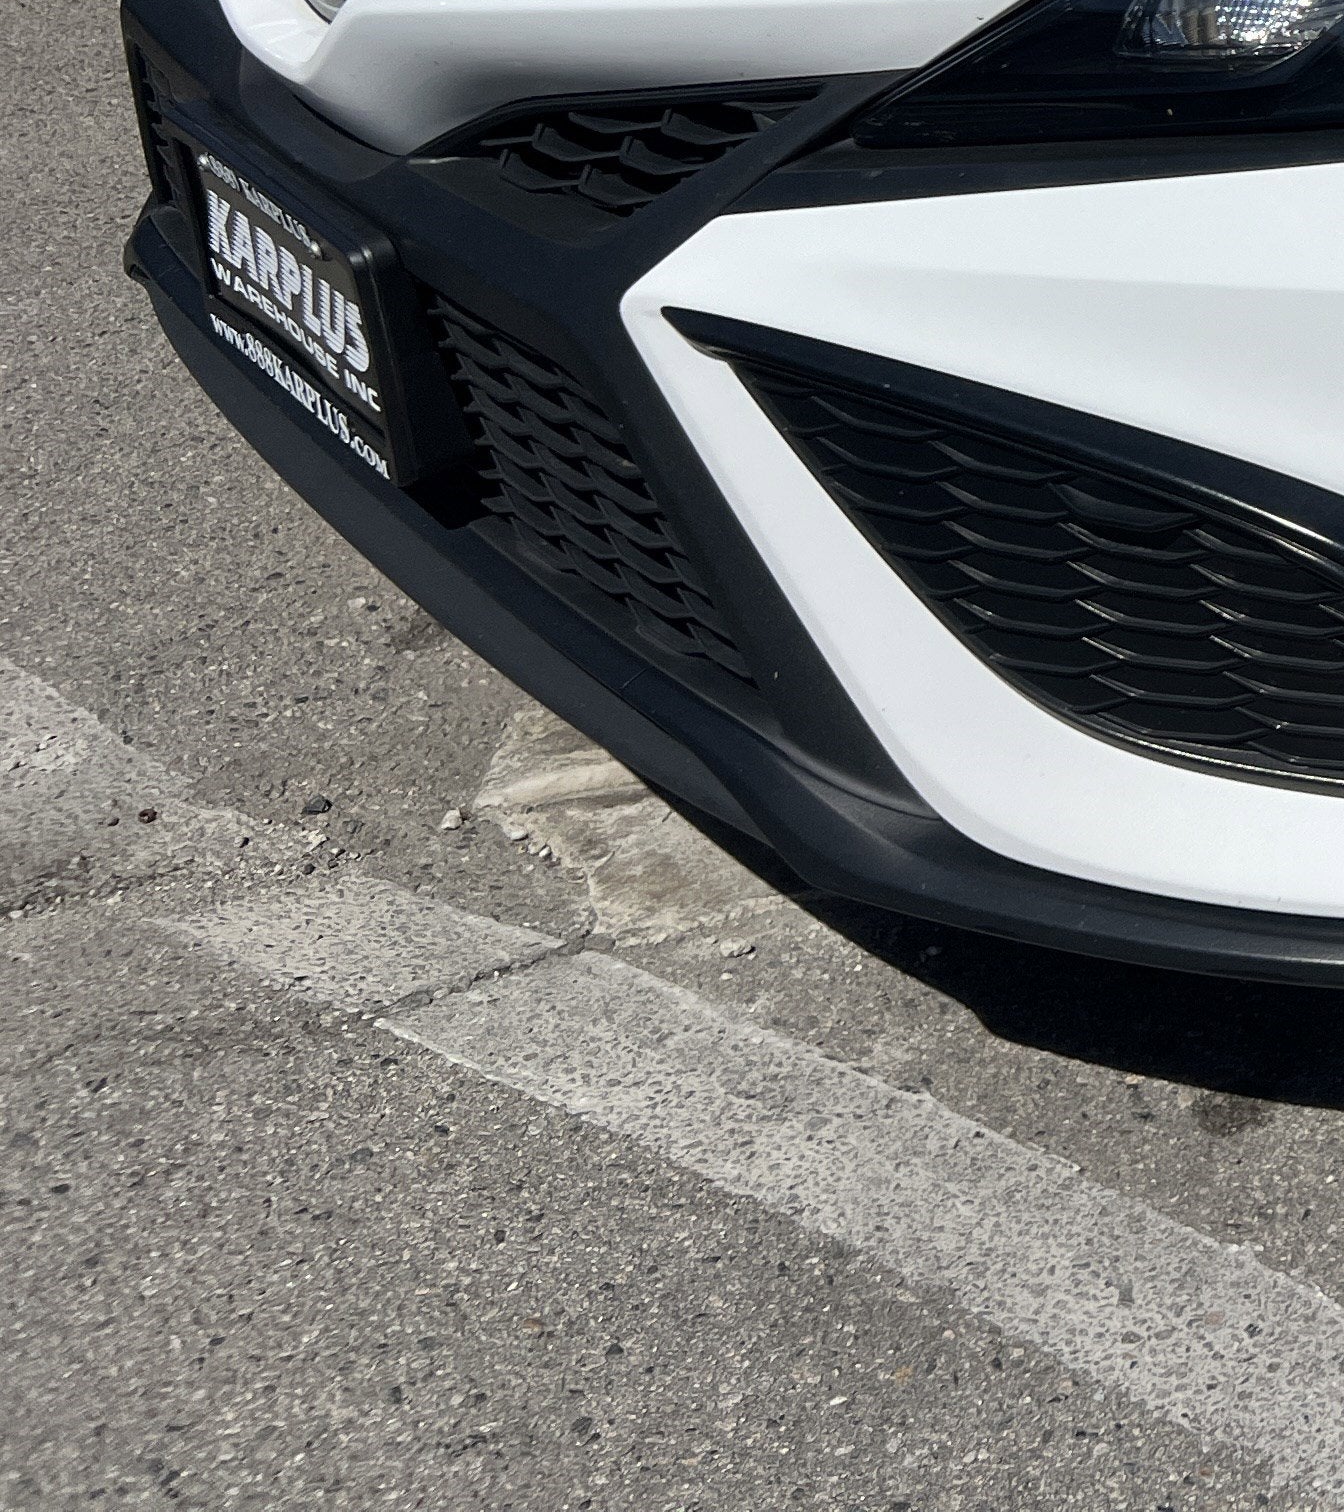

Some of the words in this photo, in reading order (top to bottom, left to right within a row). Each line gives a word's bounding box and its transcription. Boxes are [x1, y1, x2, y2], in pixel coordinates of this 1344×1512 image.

[206, 188, 370, 372] KARPLUS
[210, 257, 340, 379] WAREHOUSE
[343, 368, 382, 413] INC
